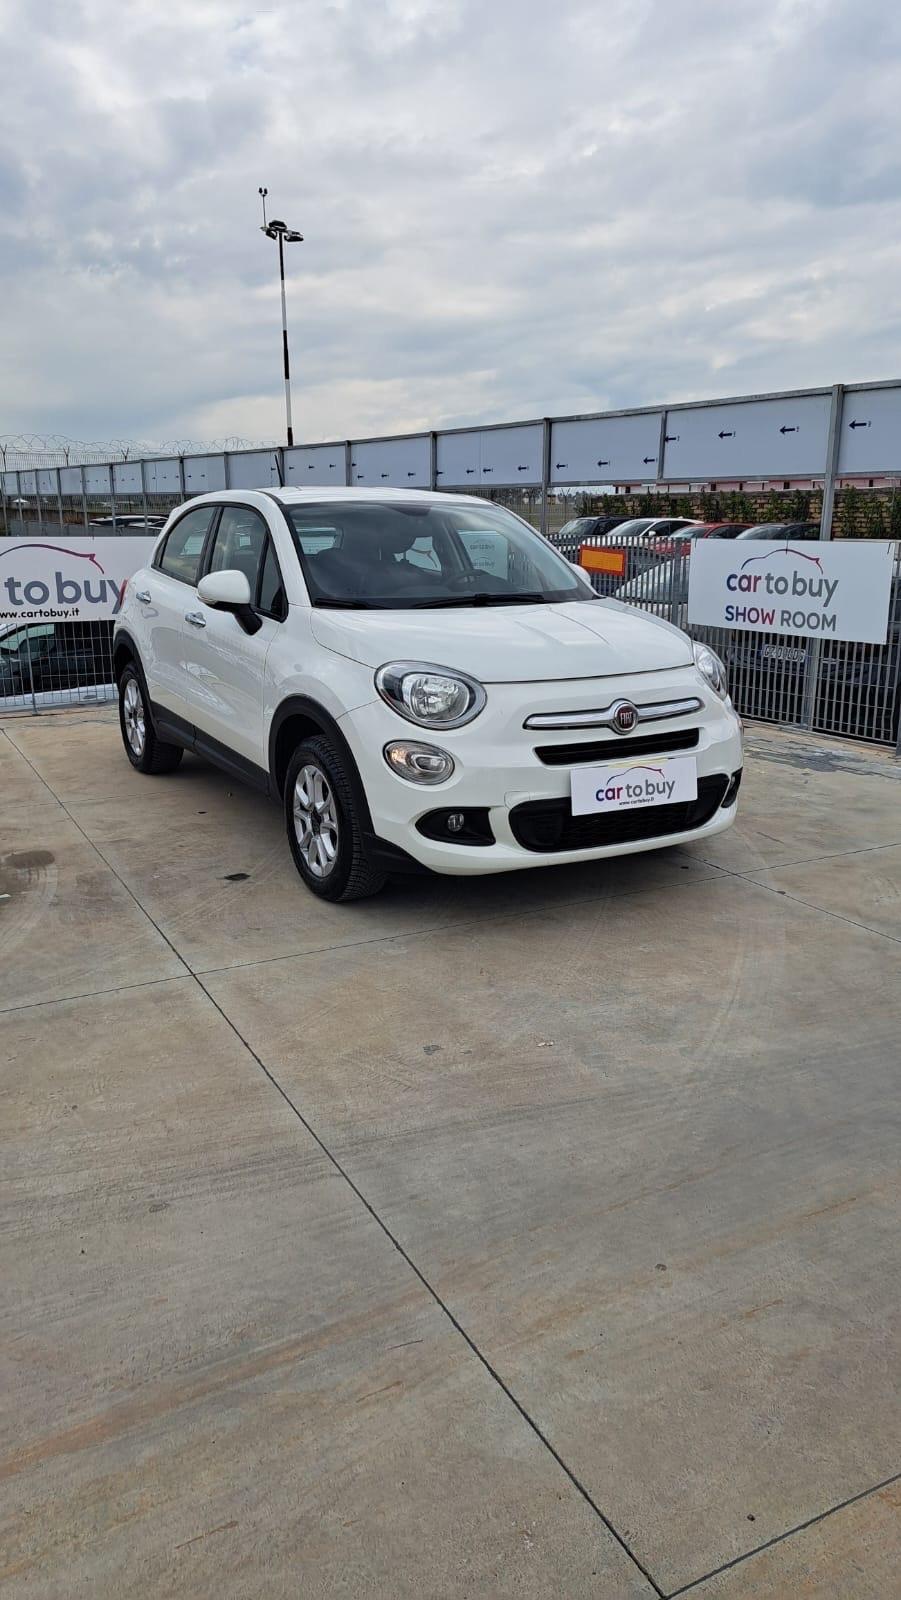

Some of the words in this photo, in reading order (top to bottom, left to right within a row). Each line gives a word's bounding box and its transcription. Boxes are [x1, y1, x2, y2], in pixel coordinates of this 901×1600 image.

[725, 605, 776, 626] SHOW
[780, 609, 837, 632] ROOM
[620, 711, 633, 725] FIAT
